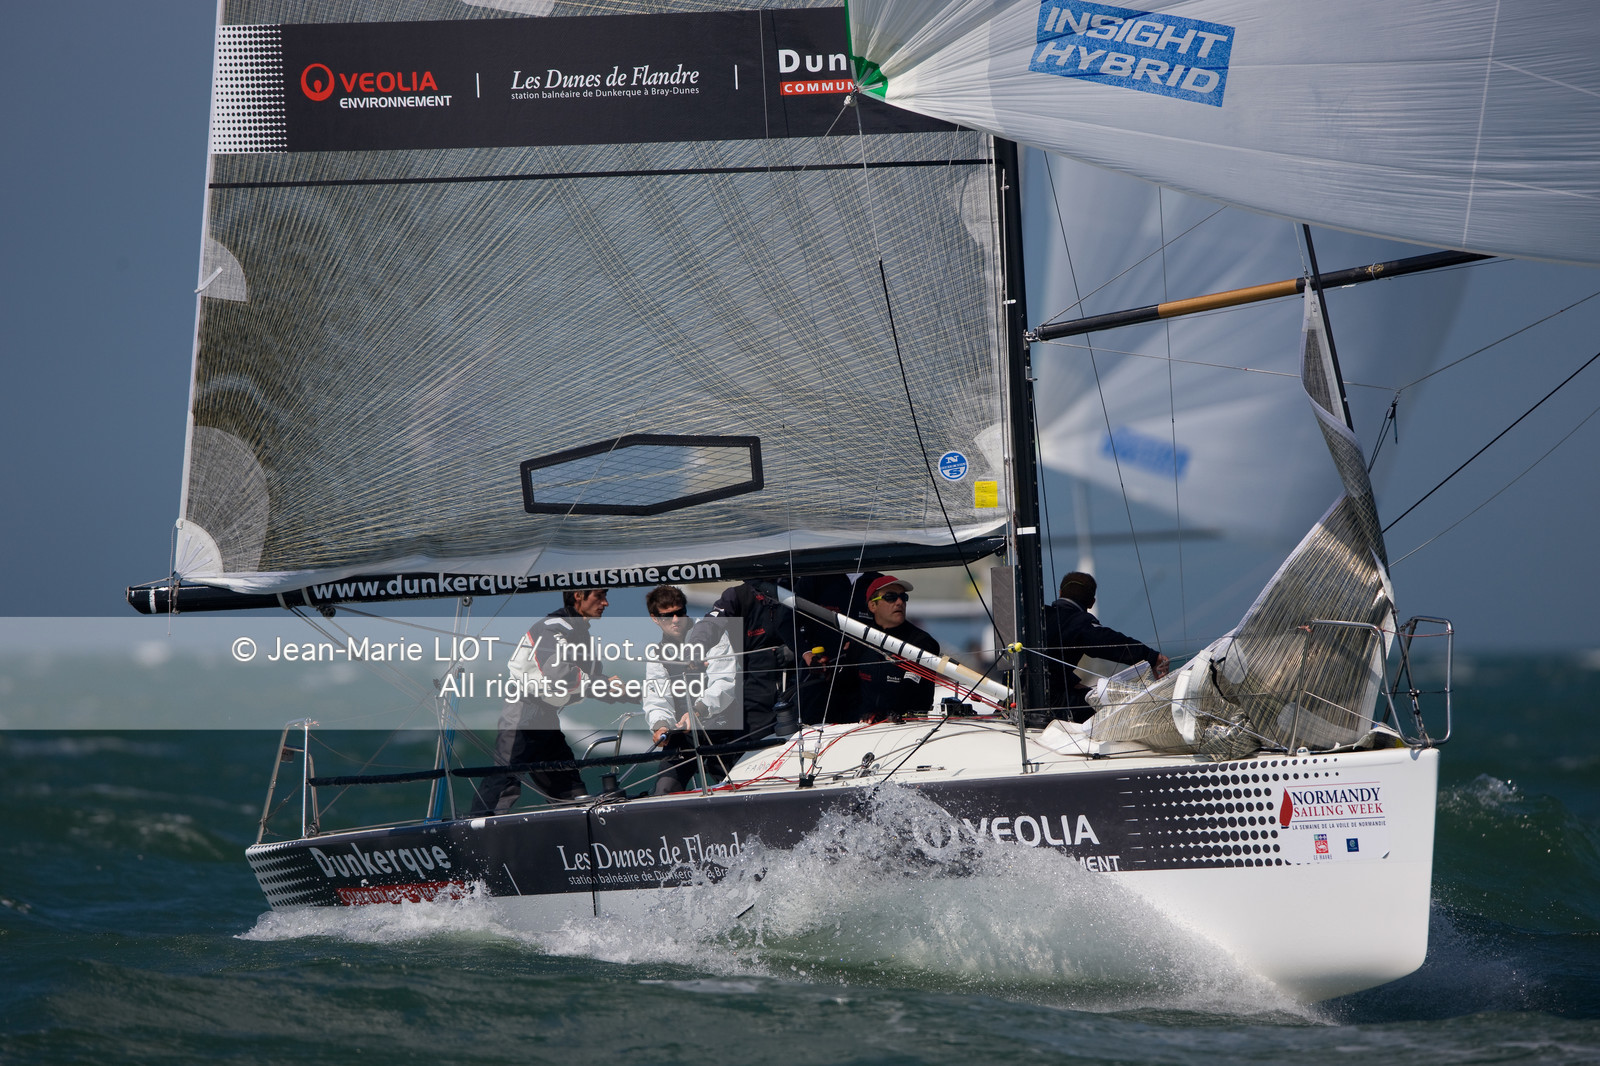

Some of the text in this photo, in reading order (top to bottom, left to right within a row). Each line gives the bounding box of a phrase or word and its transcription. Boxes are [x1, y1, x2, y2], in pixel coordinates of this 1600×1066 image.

[1044, 6, 1229, 58] INSIGHT
[511, 63, 700, 90] Les Dunes de Flandre
[1036, 41, 1220, 94] HYBRID
[339, 71, 438, 93] VEOLIA
[511, 86, 700, 100] station balnéaire de Dunkerque à Bray-Dunes
[339, 95, 452, 109] ENVIRONNEMENT
[313, 562, 721, 600] www.dunkerque-nautisme.com
[1291, 787, 1380, 806] NORMANDY
[1293, 803, 1384, 818] SAILING WEEK
[310, 842, 451, 880] Dunkerque
[557, 844, 591, 871] Les
[591, 842, 655, 870] Dunes
[658, 835, 683, 865] de
[568, 874, 598, 885] station
[599, 872, 639, 884] balnéaire
